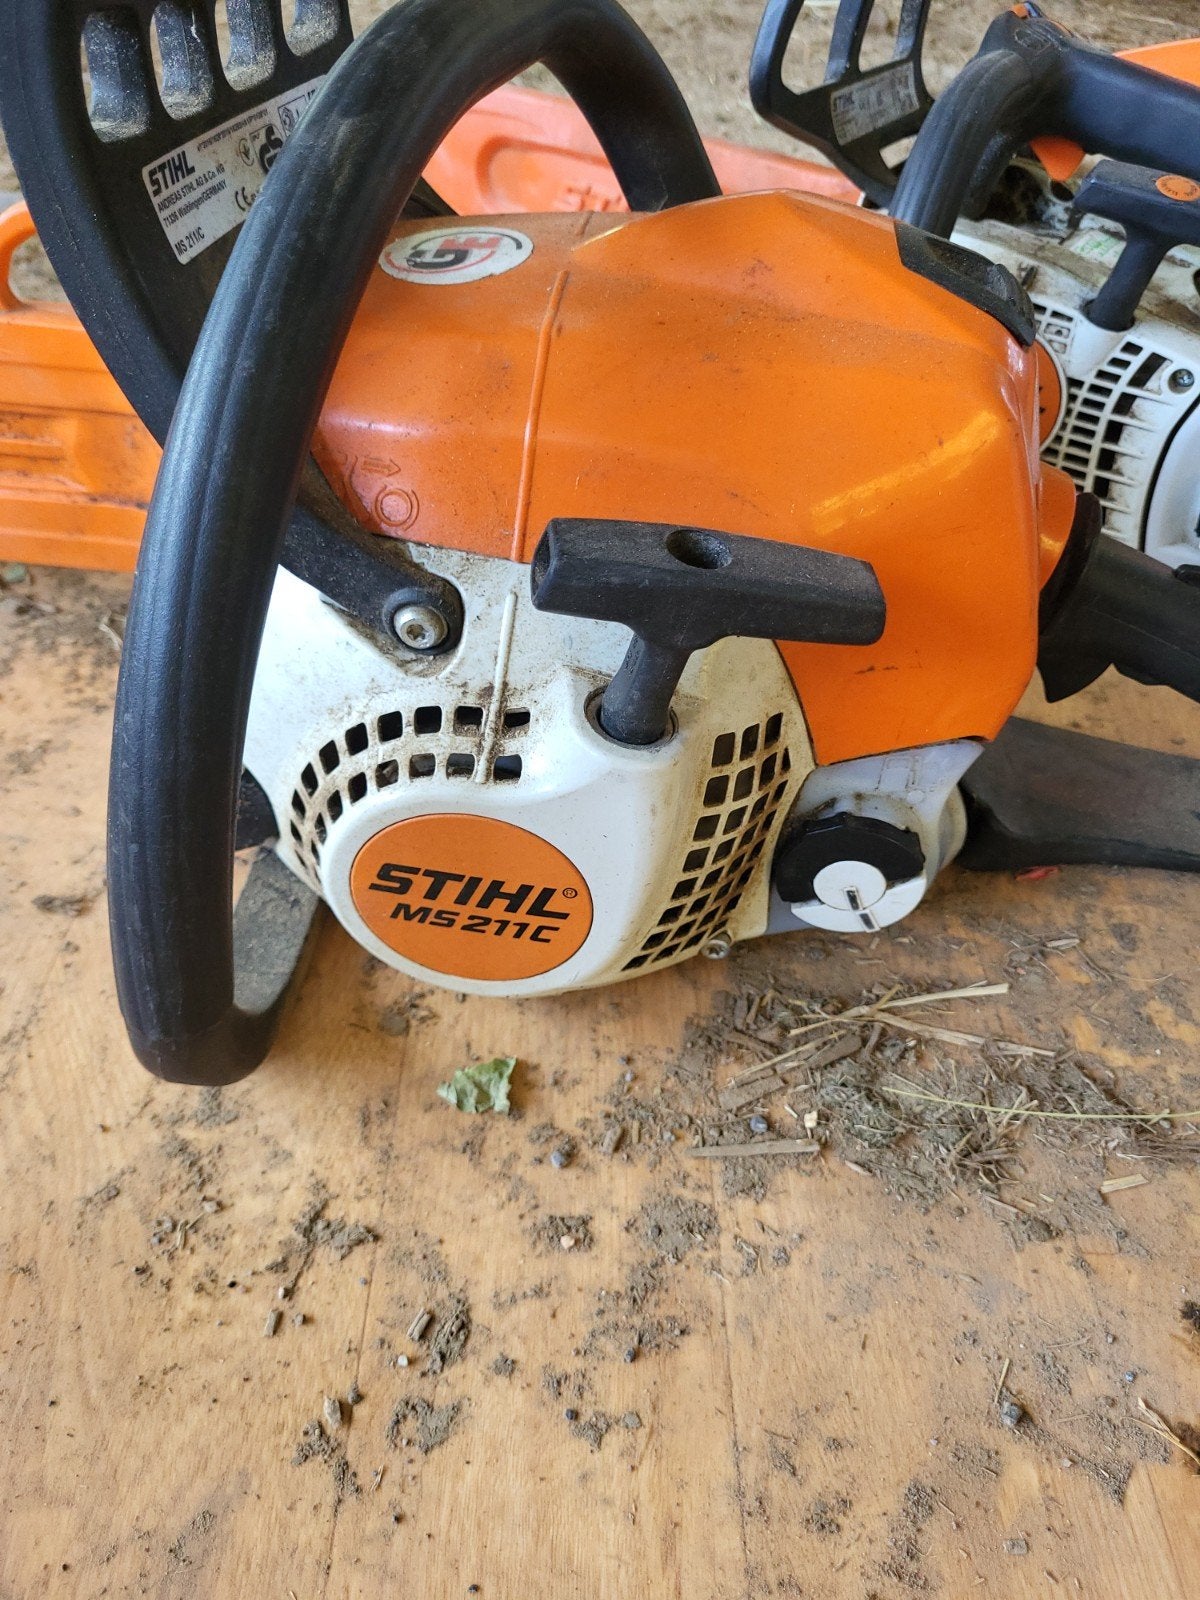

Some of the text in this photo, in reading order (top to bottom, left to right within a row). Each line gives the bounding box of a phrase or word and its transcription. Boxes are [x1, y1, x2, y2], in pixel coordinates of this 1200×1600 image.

[148, 150, 196, 197] STIHL
[157, 189, 182, 213] ANDREAS
[181, 182, 197, 197] STIHL
[174, 240, 188, 256] MS
[390, 902, 560, 943] MS 211C
